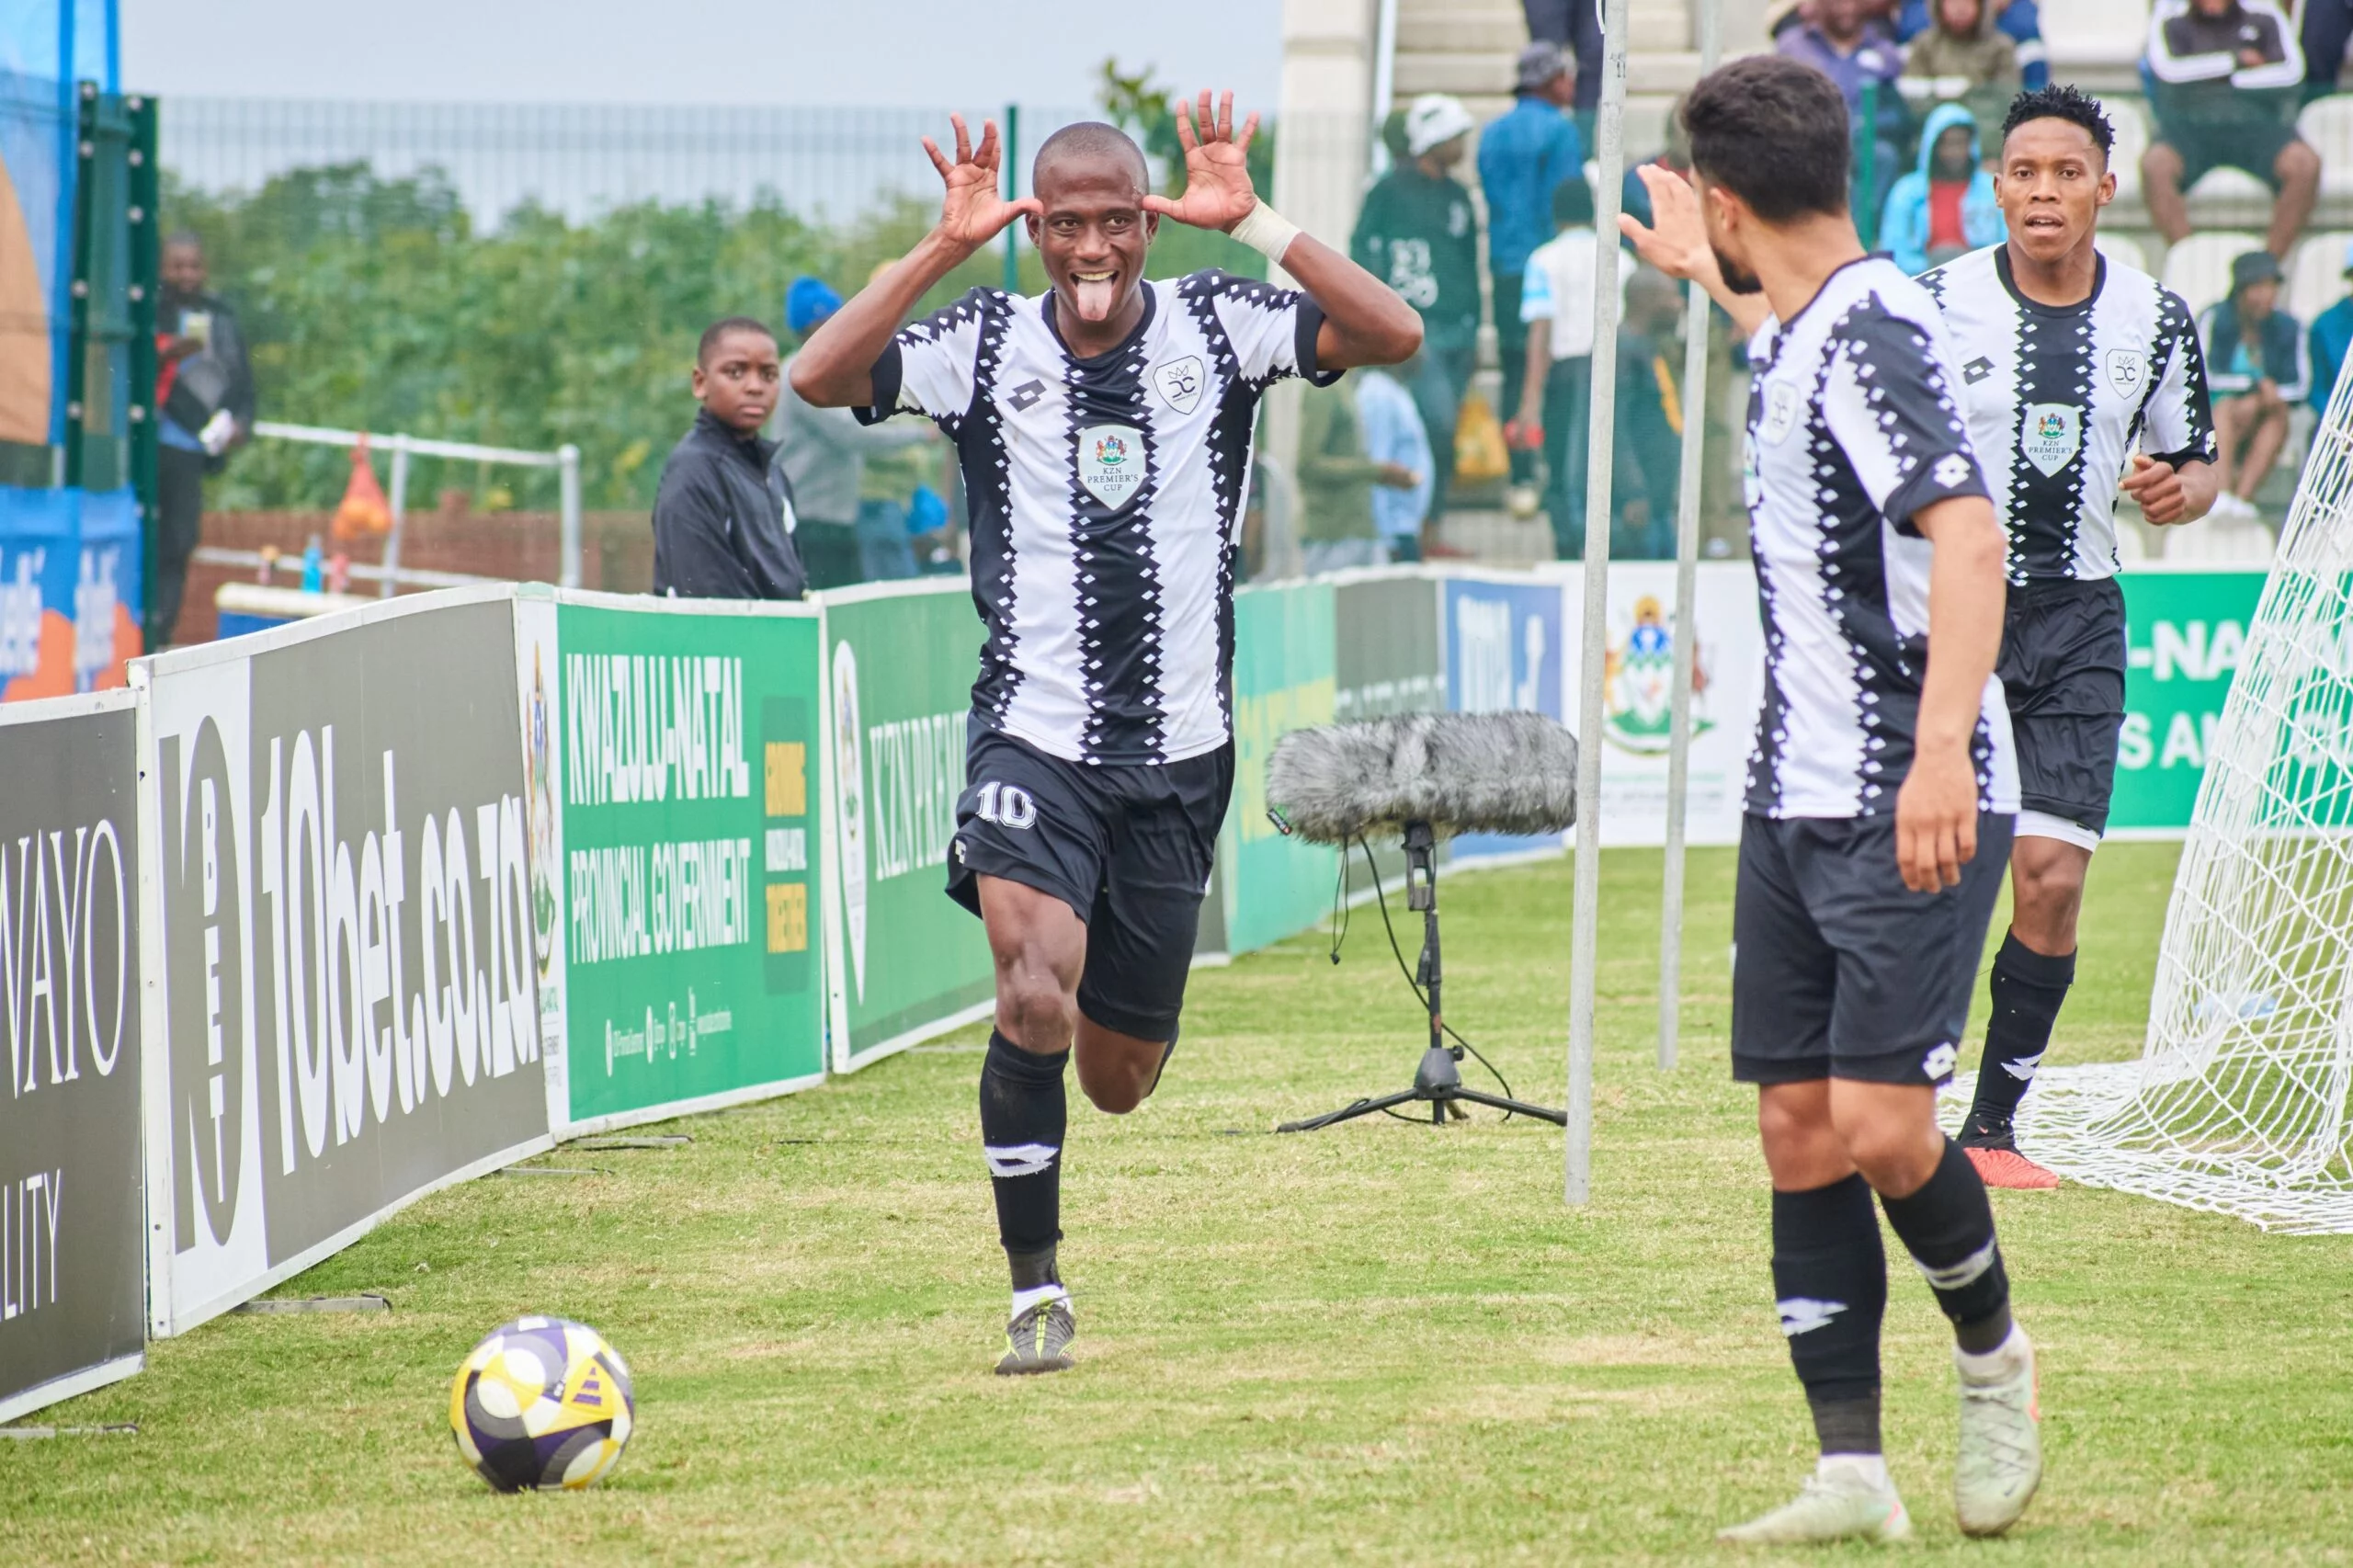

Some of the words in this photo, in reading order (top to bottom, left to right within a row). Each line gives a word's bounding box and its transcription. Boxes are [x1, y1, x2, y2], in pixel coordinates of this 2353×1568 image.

[1087, 474, 1139, 483] PREMIER'S
[1103, 483, 1123, 492] CUP
[566, 653, 750, 806] KWAZULU-NATAL
[869, 722, 912, 881] KZN
[975, 781, 1037, 830] 10
[261, 724, 539, 1176] 10bet.co.za
[571, 845, 652, 965] PROVINCIAL
[651, 837, 751, 955] GOVERNMENT
[200, 778, 224, 1205] BET
